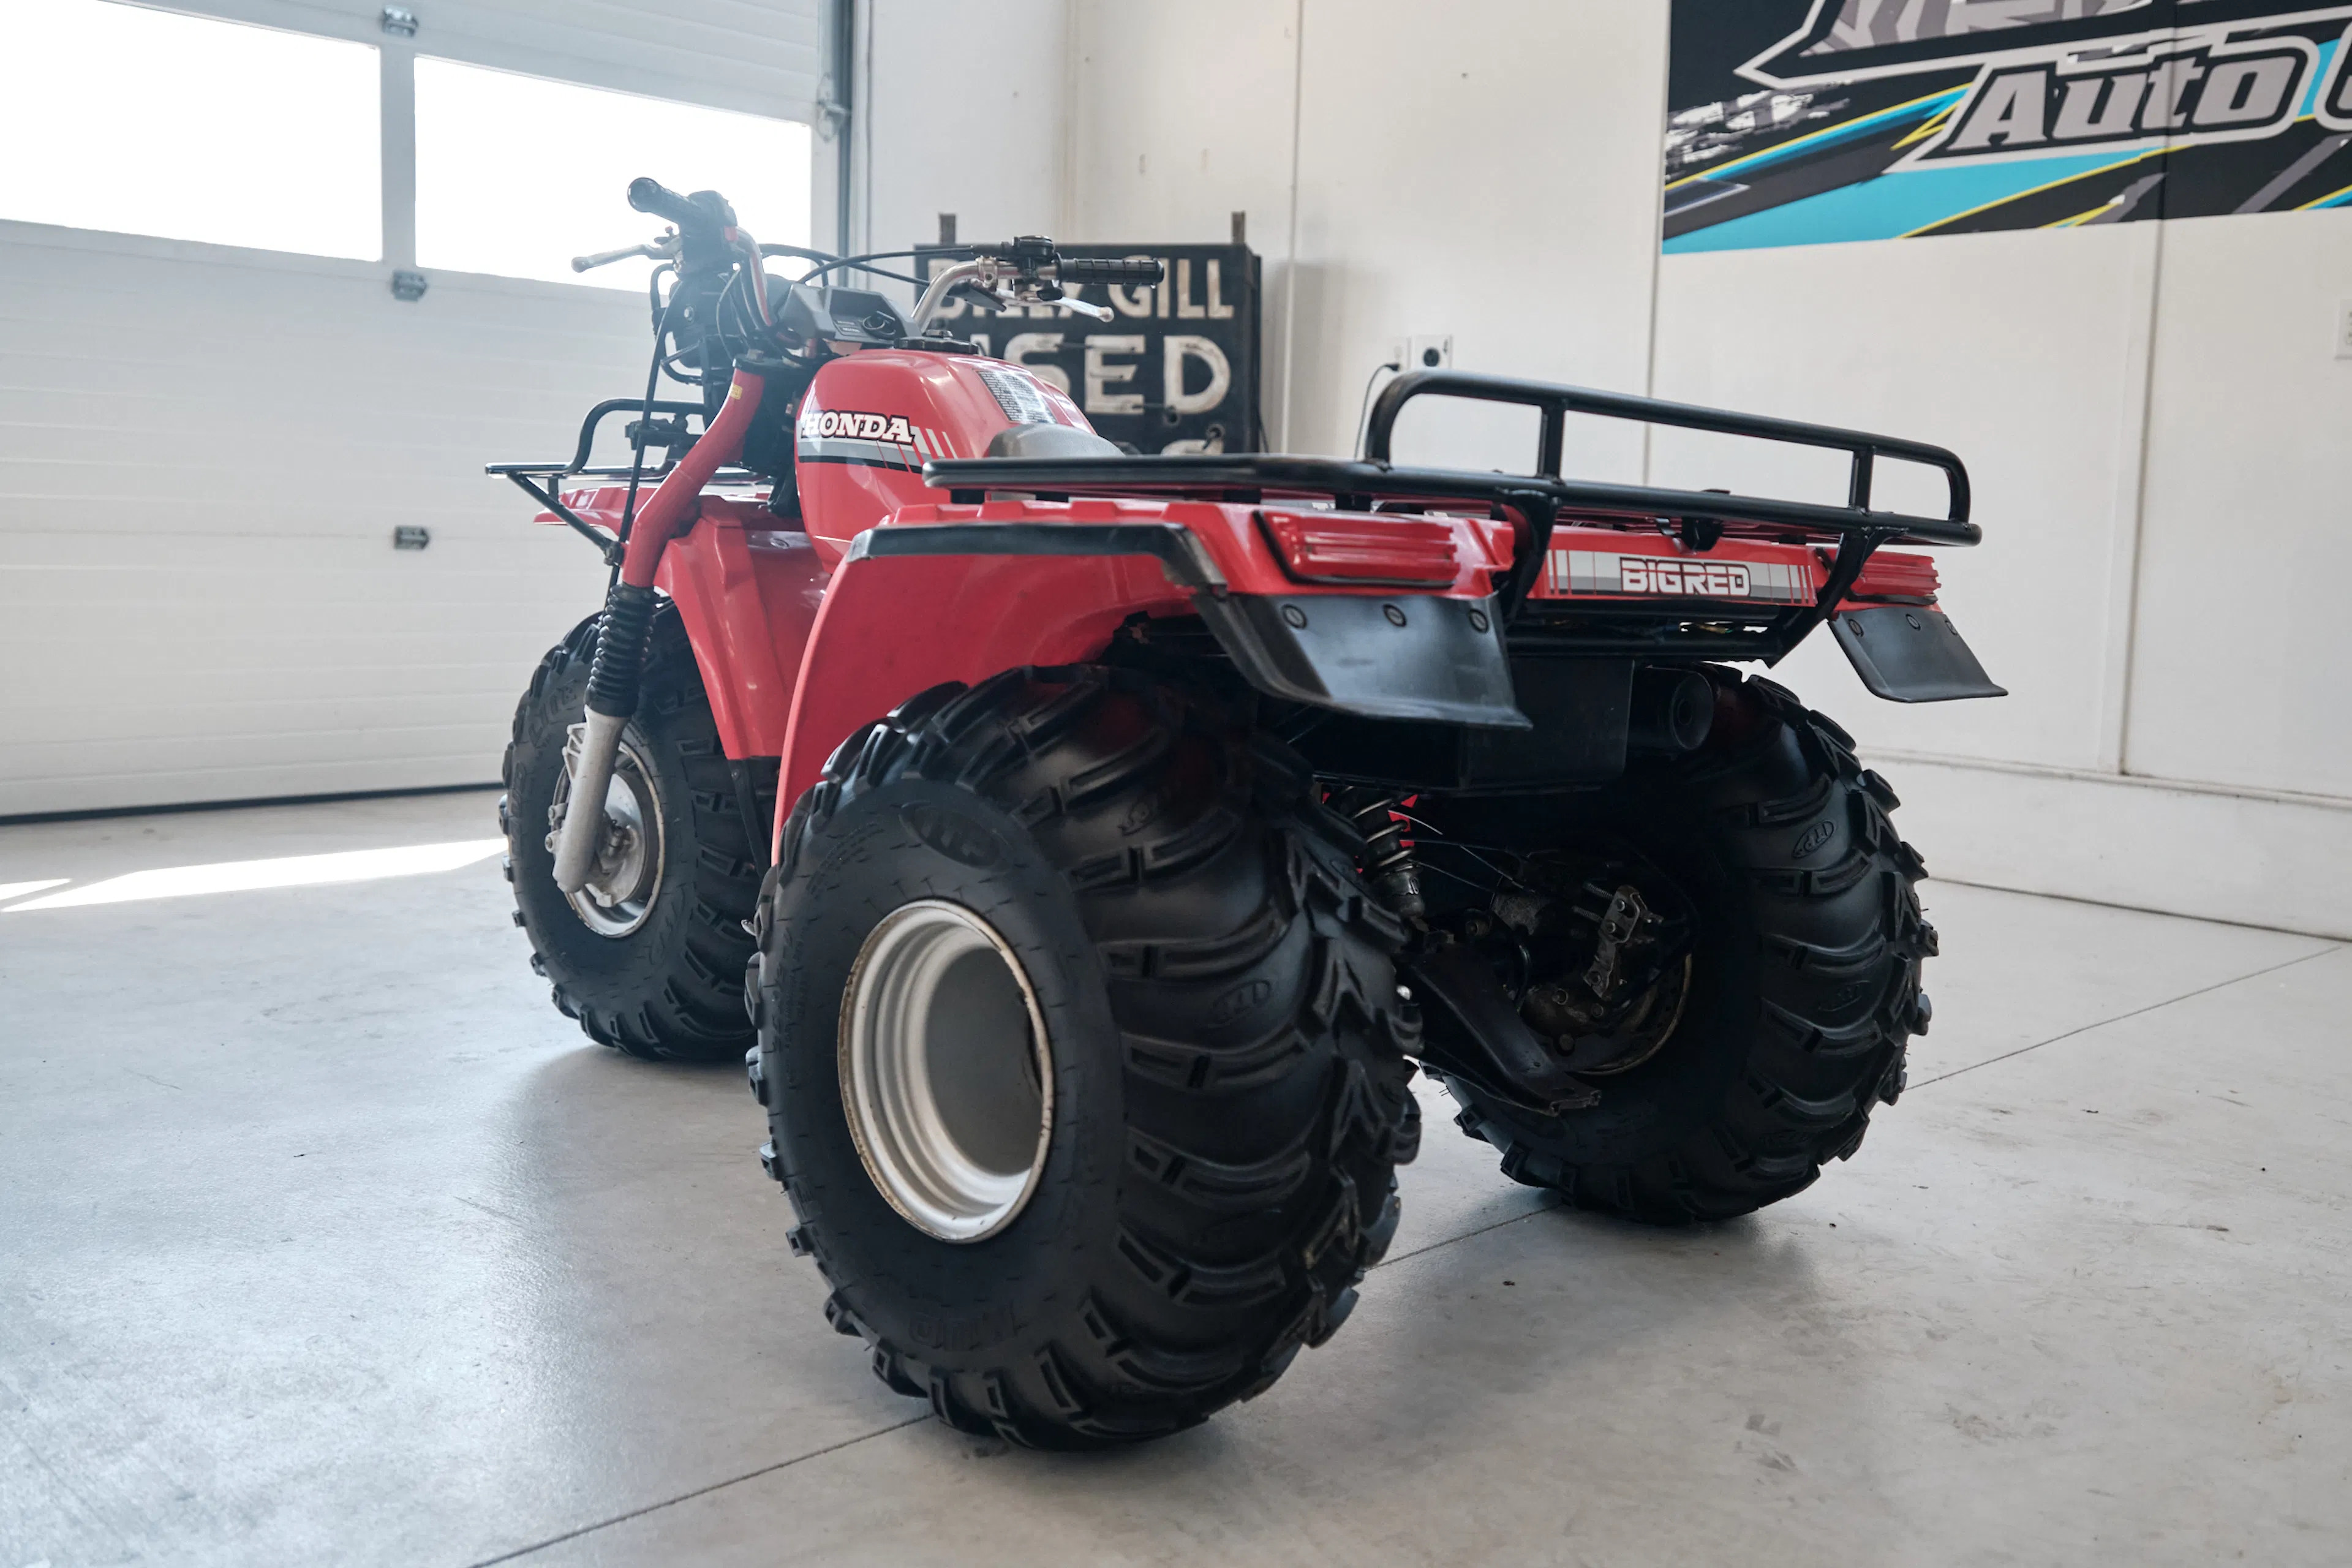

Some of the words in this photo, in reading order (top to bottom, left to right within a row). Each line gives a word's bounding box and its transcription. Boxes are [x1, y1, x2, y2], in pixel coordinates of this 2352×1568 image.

[1946, 55, 2297, 151] Auto
[978, 333, 1231, 415] SED
[802, 410, 914, 445] HONDA
